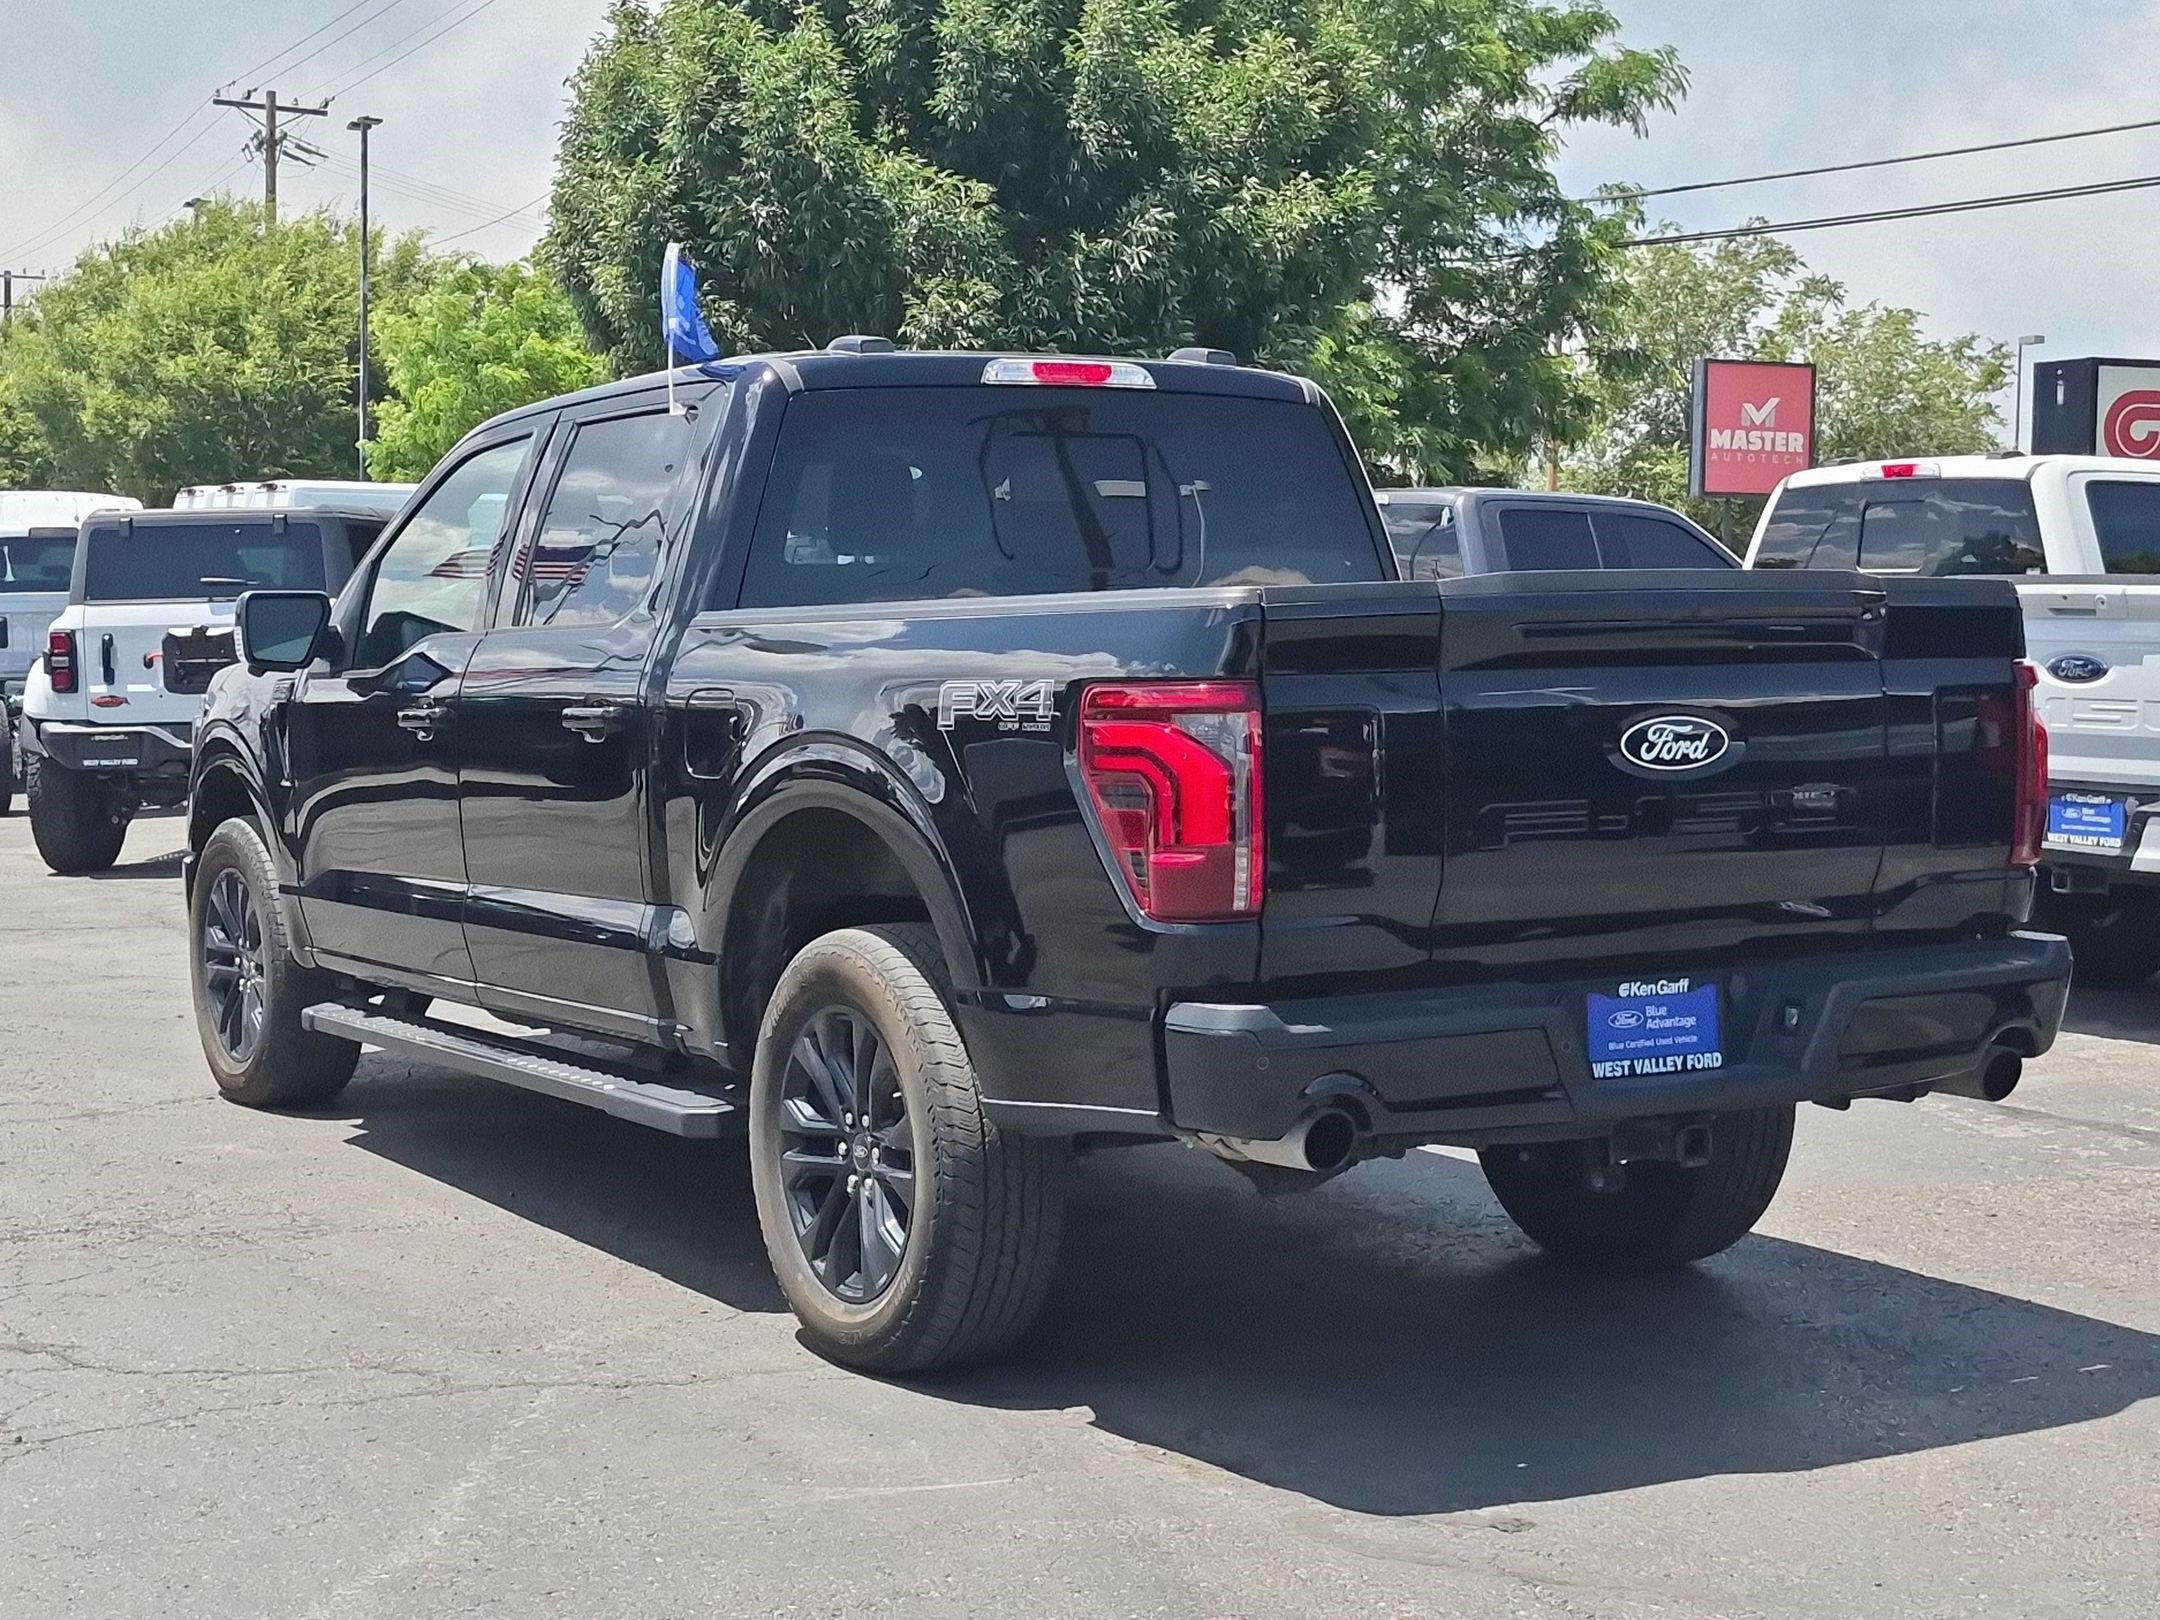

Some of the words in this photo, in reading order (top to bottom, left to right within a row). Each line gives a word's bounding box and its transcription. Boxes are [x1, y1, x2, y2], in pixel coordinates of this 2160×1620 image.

[1710, 428, 1804, 452] MASTER
[1711, 453, 1803, 465] AUTOTECH
[2058, 659, 2093, 677] Ford
[937, 679, 1055, 730] FX4
[1640, 723, 1711, 760] Ford
[1646, 1006, 1667, 1017] Blue
[1646, 1015, 1697, 1030] Advantage
[1608, 1042, 1624, 1050] Blue
[1625, 1038, 1654, 1049] Certified
[1656, 1037, 1673, 1046] Used
[1674, 1035, 1698, 1044] Vehicle
[1592, 1060, 1631, 1079] WEST
[1633, 1055, 1684, 1075] VALLEY
[1687, 1052, 1722, 1070] FORD
